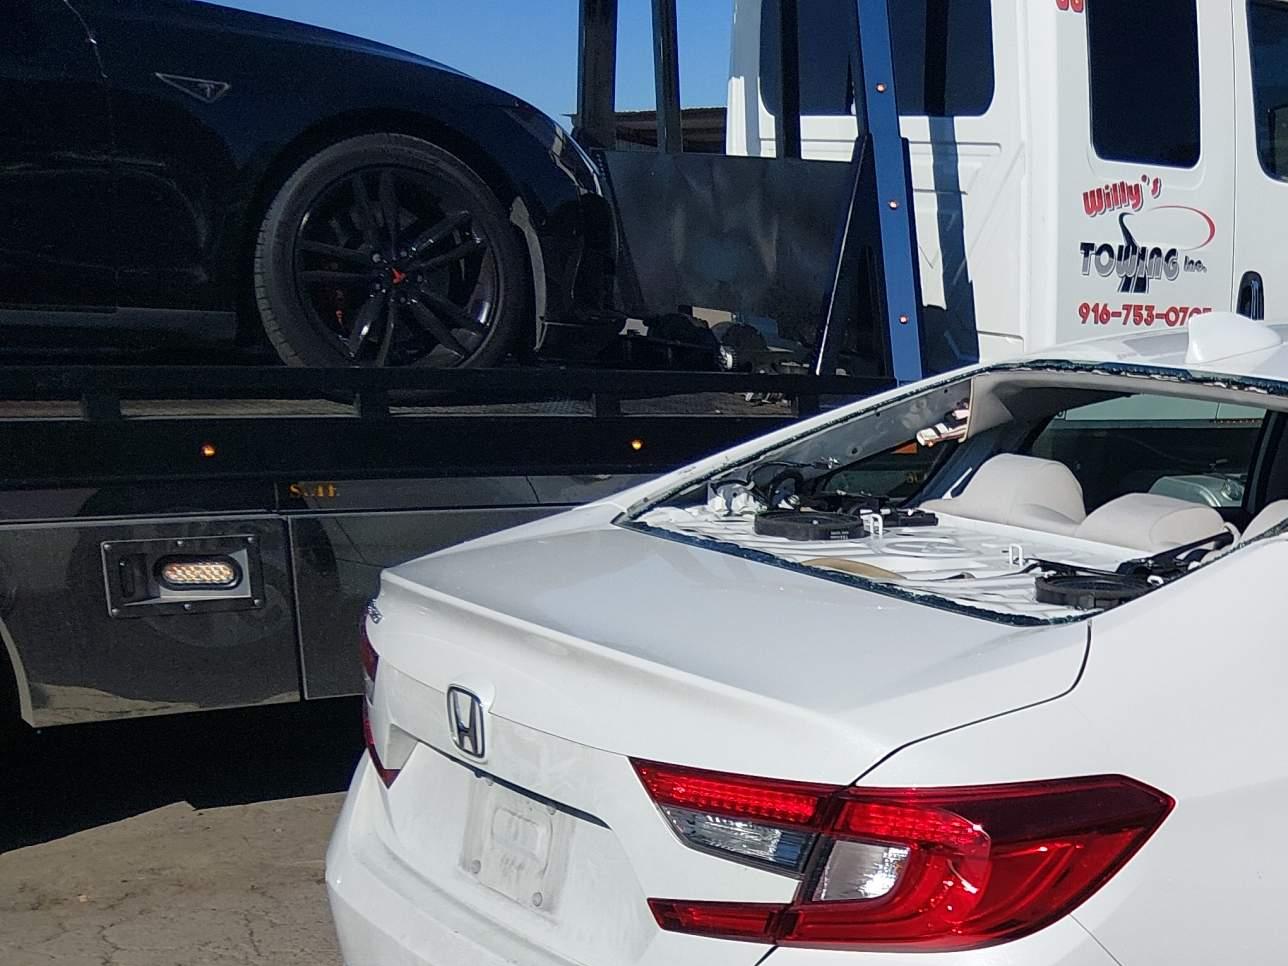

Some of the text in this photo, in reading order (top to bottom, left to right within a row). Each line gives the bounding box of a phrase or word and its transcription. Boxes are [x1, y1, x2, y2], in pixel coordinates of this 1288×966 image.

[1082, 174, 1162, 217] Willy's
[1080, 242, 1207, 281] TOWING Inc.
